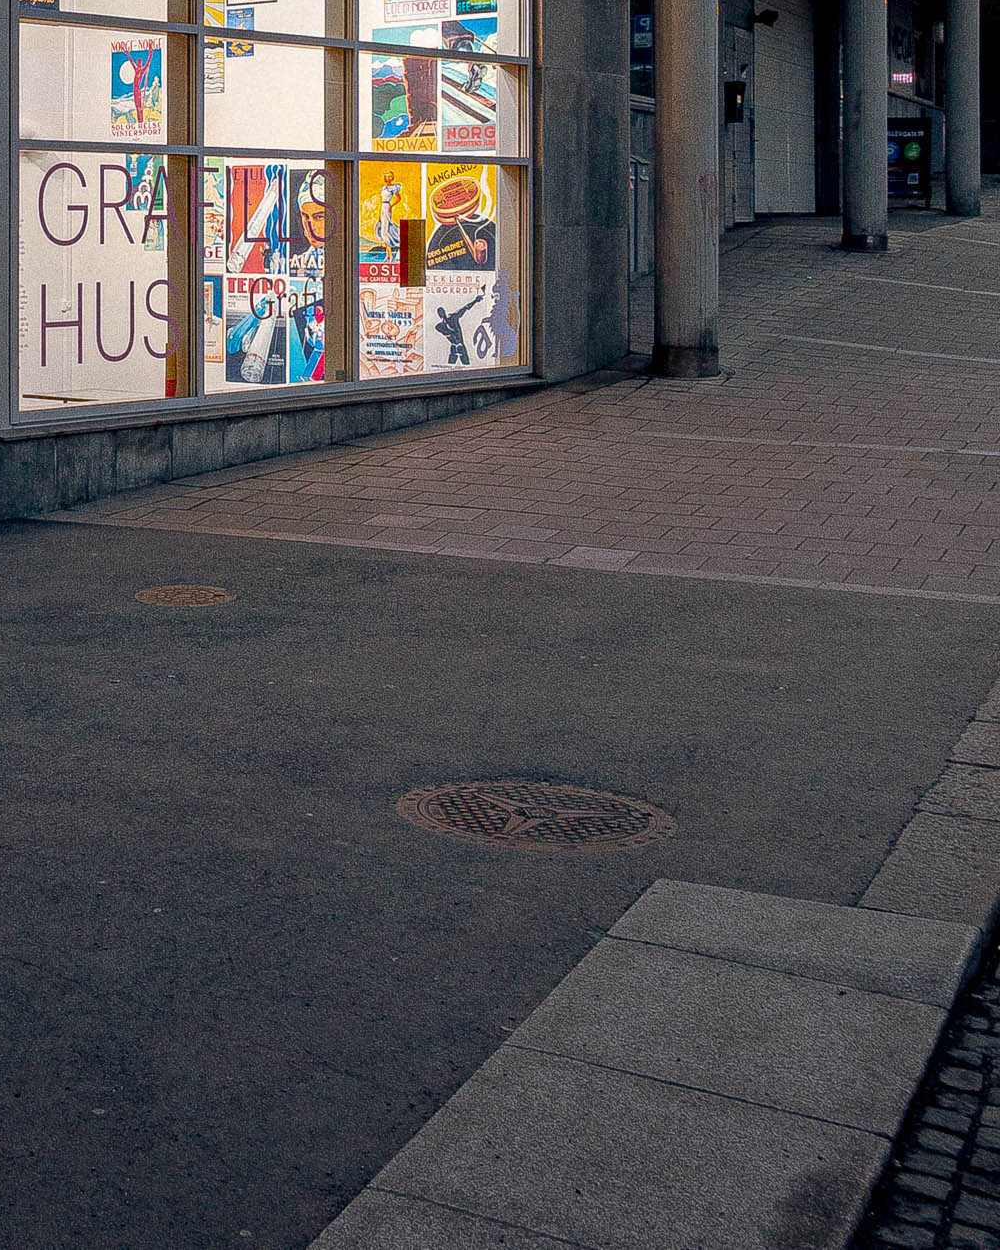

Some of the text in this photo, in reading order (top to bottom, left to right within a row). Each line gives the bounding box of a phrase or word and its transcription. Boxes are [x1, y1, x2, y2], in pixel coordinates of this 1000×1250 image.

[457, 0, 471, 12] SEE
[111, 129, 162, 138] VINTERSPORT
[376, 138, 436, 151] NORWAY
[369, 265, 399, 277] OSL
[226, 277, 287, 295] TEMPO
[41, 280, 179, 367] HUS
